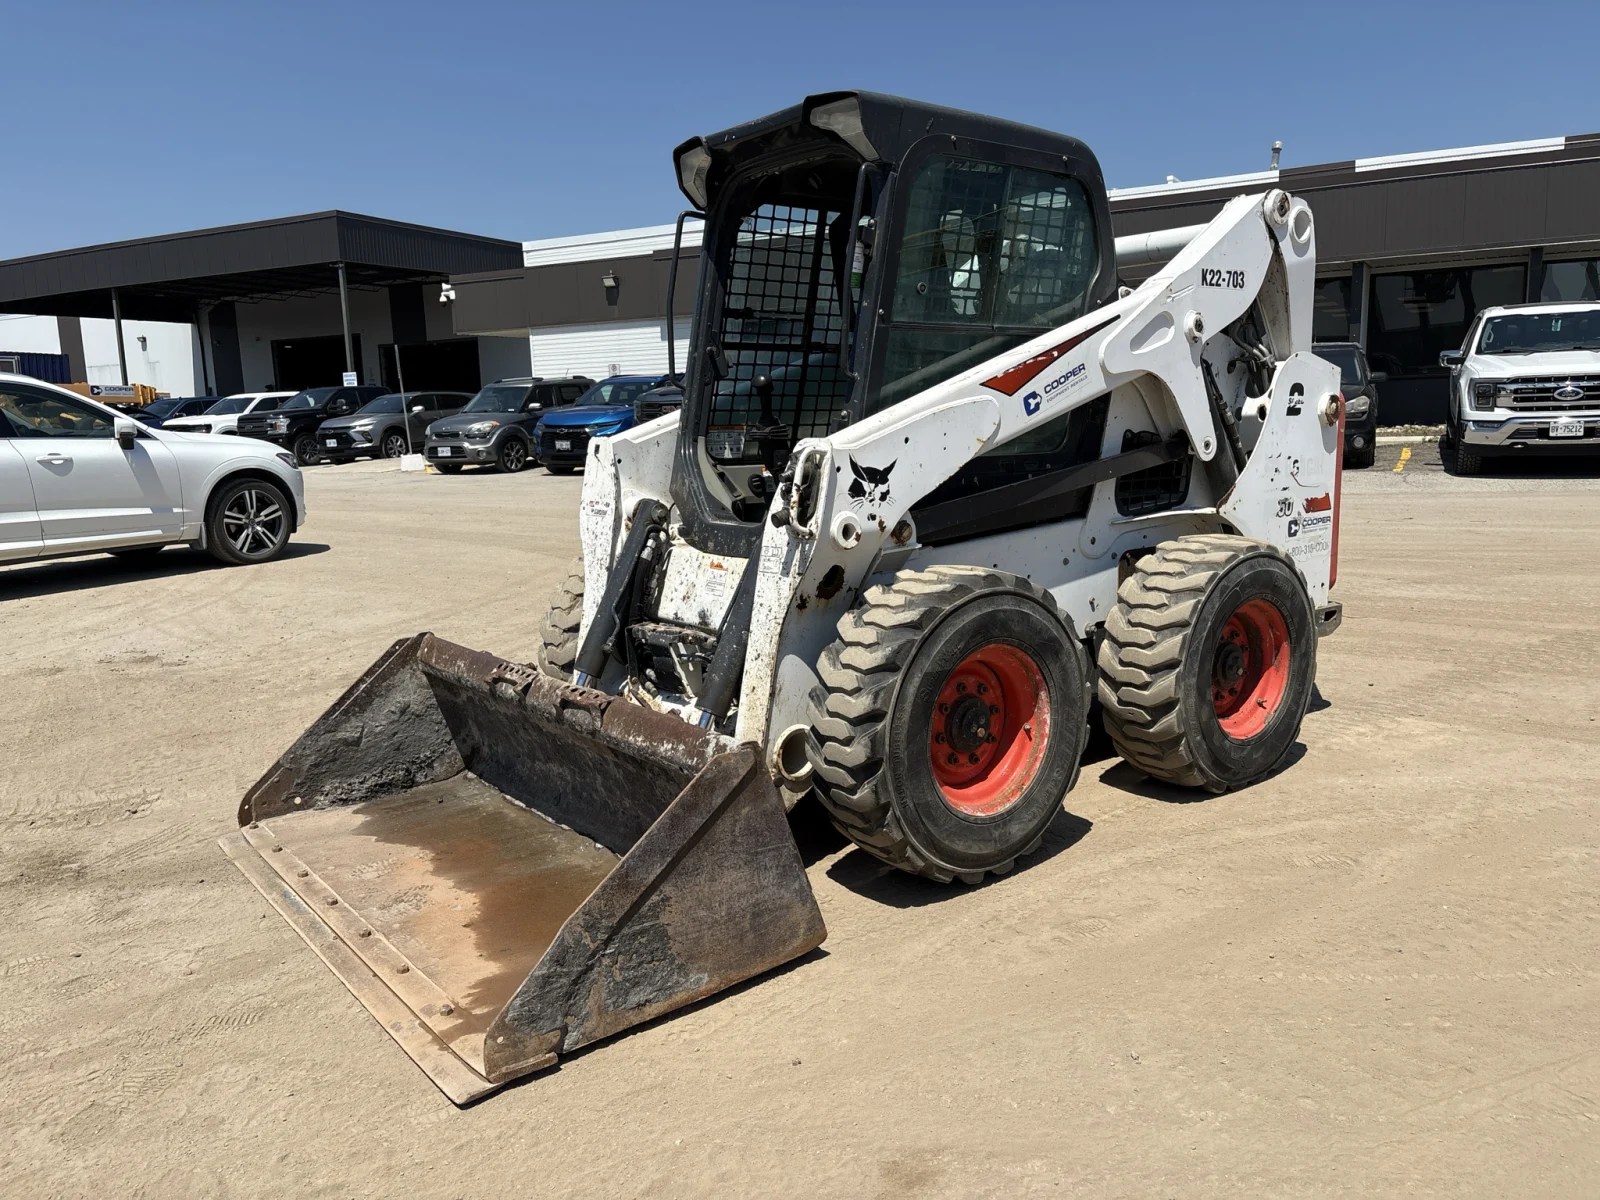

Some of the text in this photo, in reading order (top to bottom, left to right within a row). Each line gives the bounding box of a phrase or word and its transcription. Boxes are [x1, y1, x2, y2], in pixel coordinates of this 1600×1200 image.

[1201, 268, 1245, 289] K22-703
[1044, 363, 1086, 394] COOPER
[1302, 515, 1331, 527] COOPER
